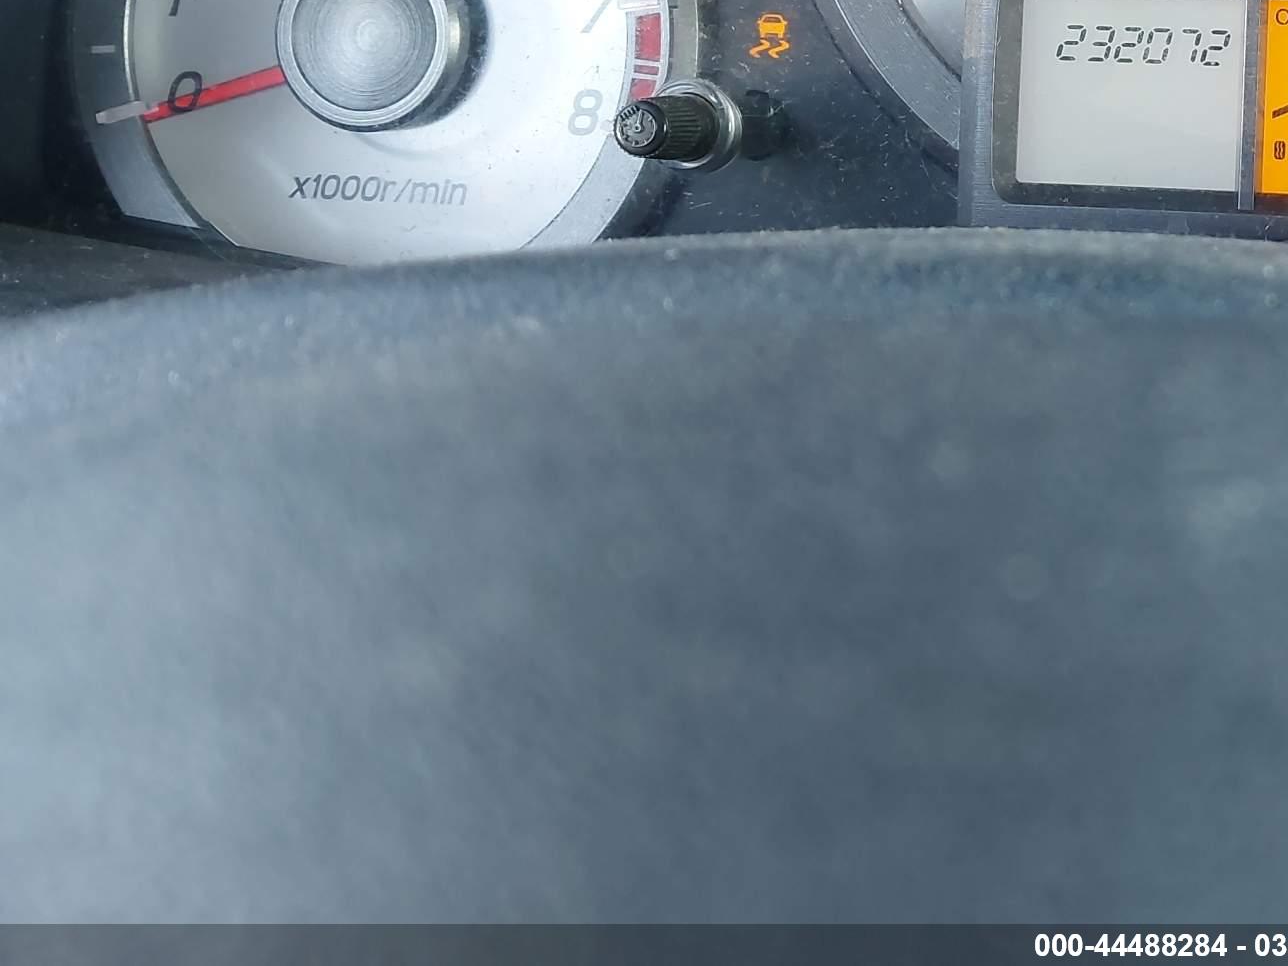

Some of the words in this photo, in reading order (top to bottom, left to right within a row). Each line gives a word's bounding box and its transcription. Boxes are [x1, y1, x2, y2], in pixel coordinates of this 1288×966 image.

[1056, 24, 1232, 67] 232072
[166, 70, 203, 113] 0
[568, 88, 603, 136] 8
